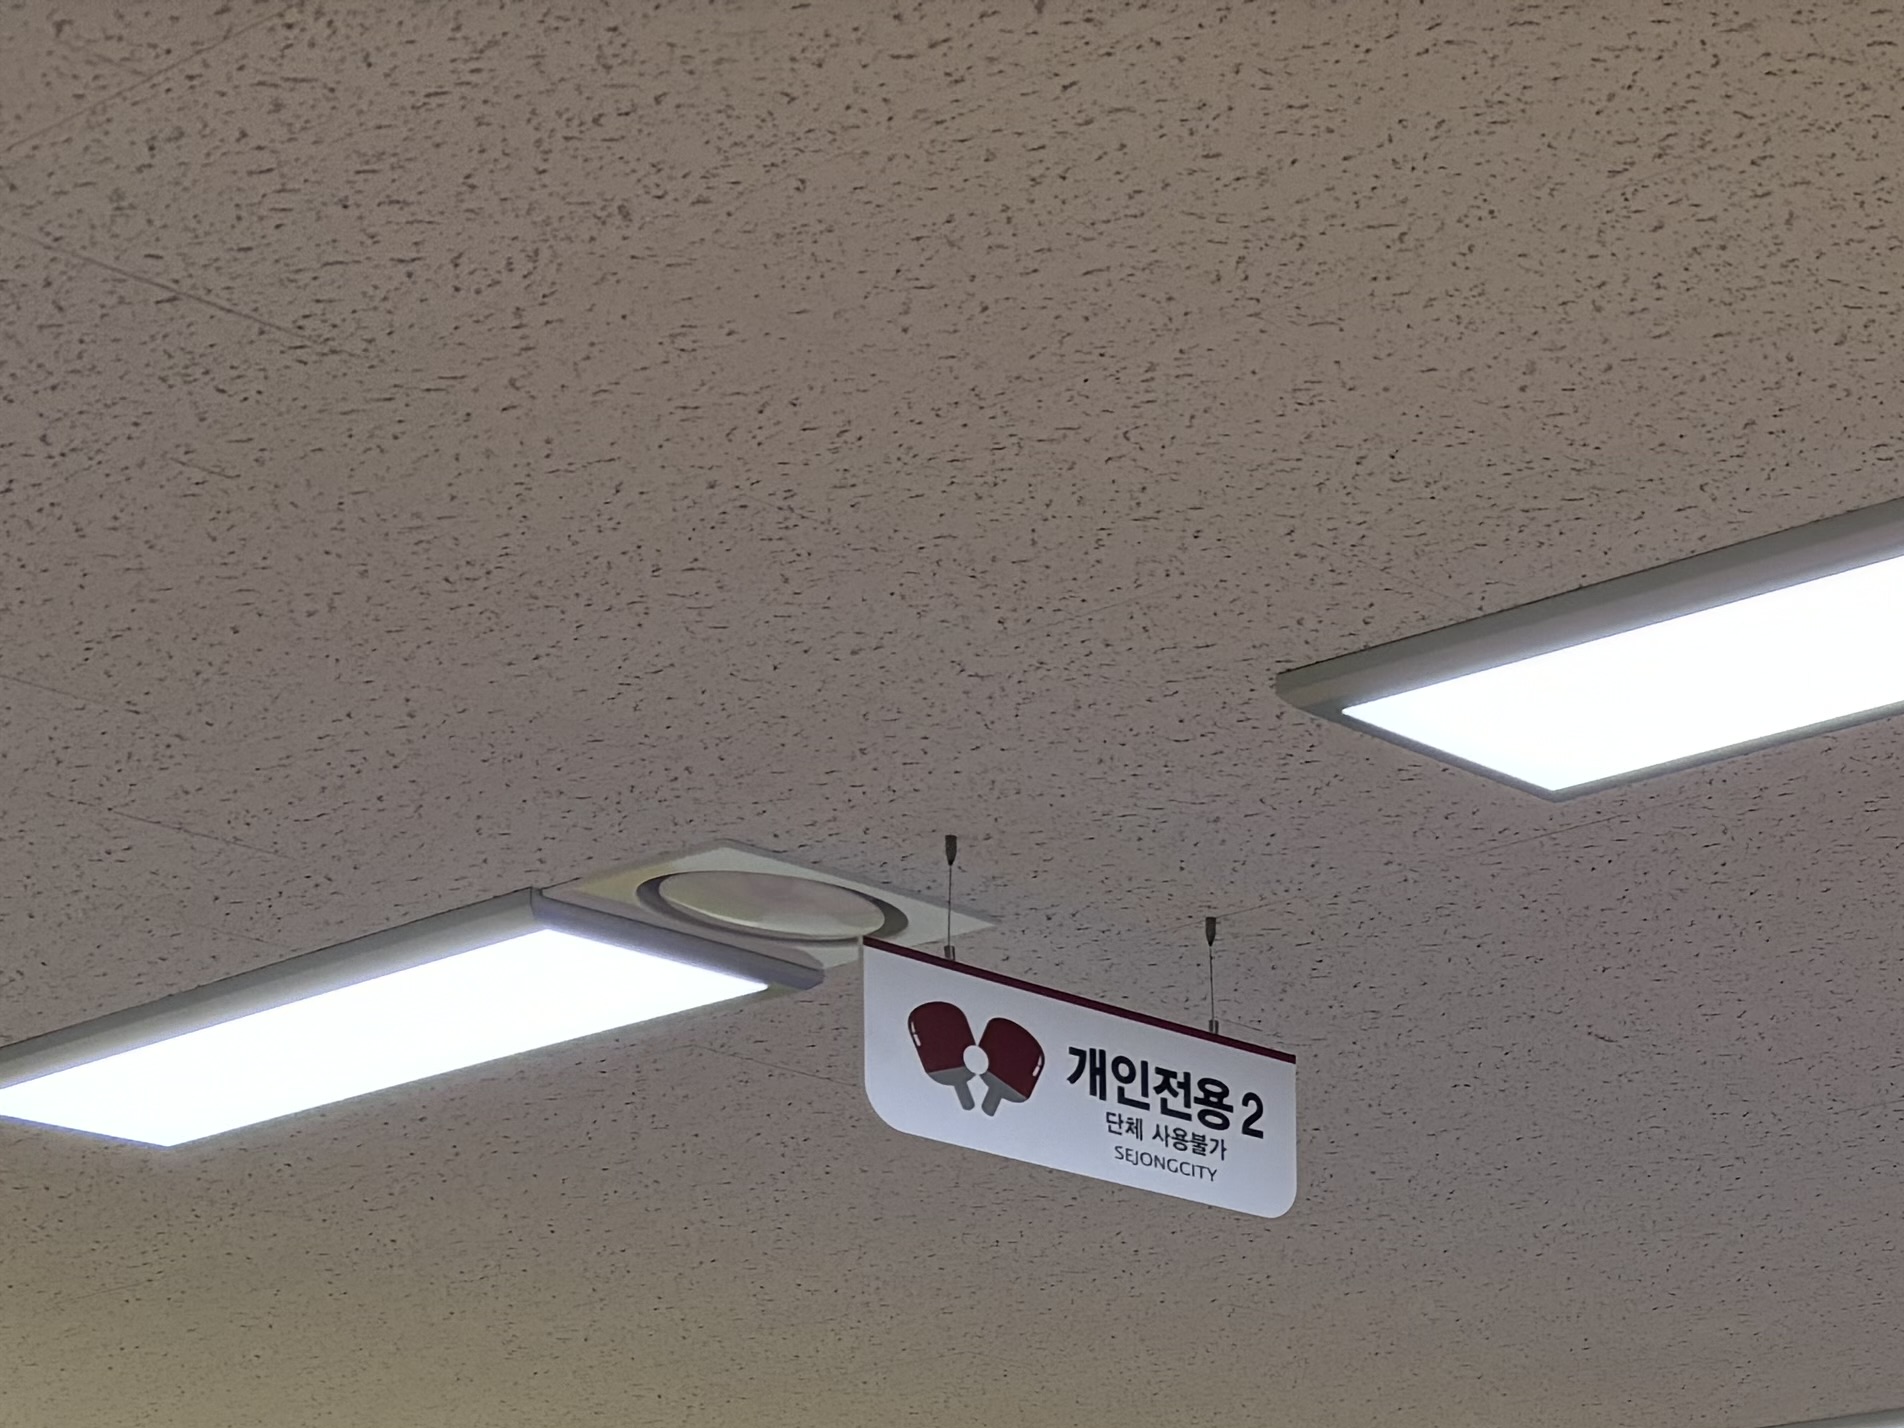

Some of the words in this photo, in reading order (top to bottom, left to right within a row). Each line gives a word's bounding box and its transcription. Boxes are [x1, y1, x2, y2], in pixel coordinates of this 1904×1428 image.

[1105, 1111, 1144, 1142] 단체
[1151, 1123, 1228, 1161] 사용불가
[1114, 1145, 1218, 1182] SEJONGCITY
